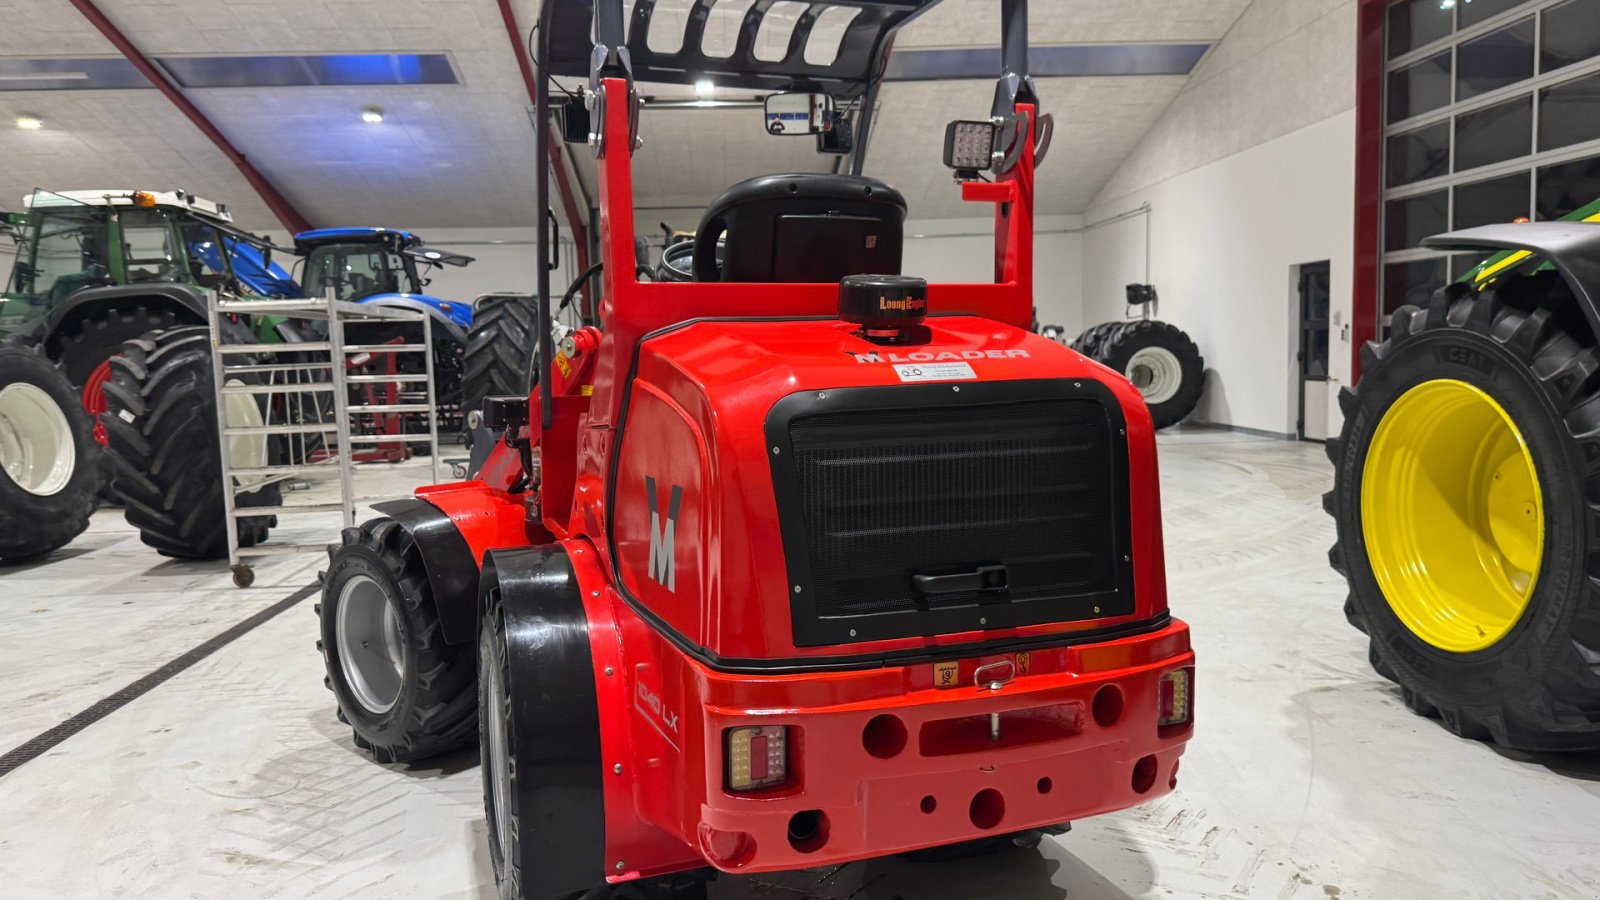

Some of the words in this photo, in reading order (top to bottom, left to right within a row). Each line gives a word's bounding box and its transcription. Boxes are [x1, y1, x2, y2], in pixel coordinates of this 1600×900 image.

[889, 349, 1030, 362] LOADER
[1448, 346, 1485, 367] CEAT
[662, 704, 678, 734] LX
